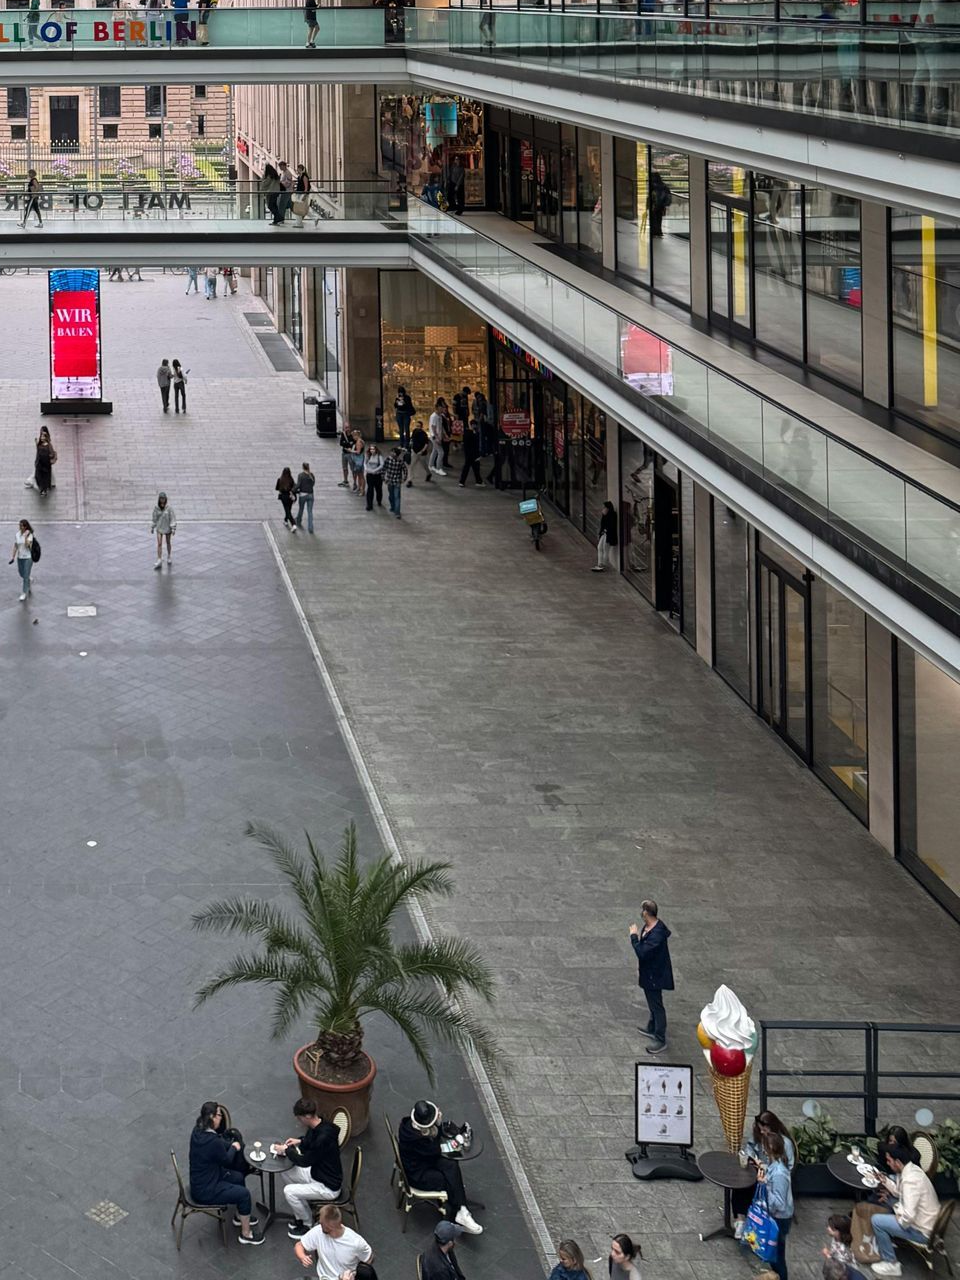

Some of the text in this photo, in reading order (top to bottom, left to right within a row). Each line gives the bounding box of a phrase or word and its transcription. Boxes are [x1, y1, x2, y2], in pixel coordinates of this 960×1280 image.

[40, 21, 78, 43] OF
[93, 20, 197, 42] BERLIN
[56, 308, 93, 323] WIR
[57, 327, 94, 337] BAUEN
